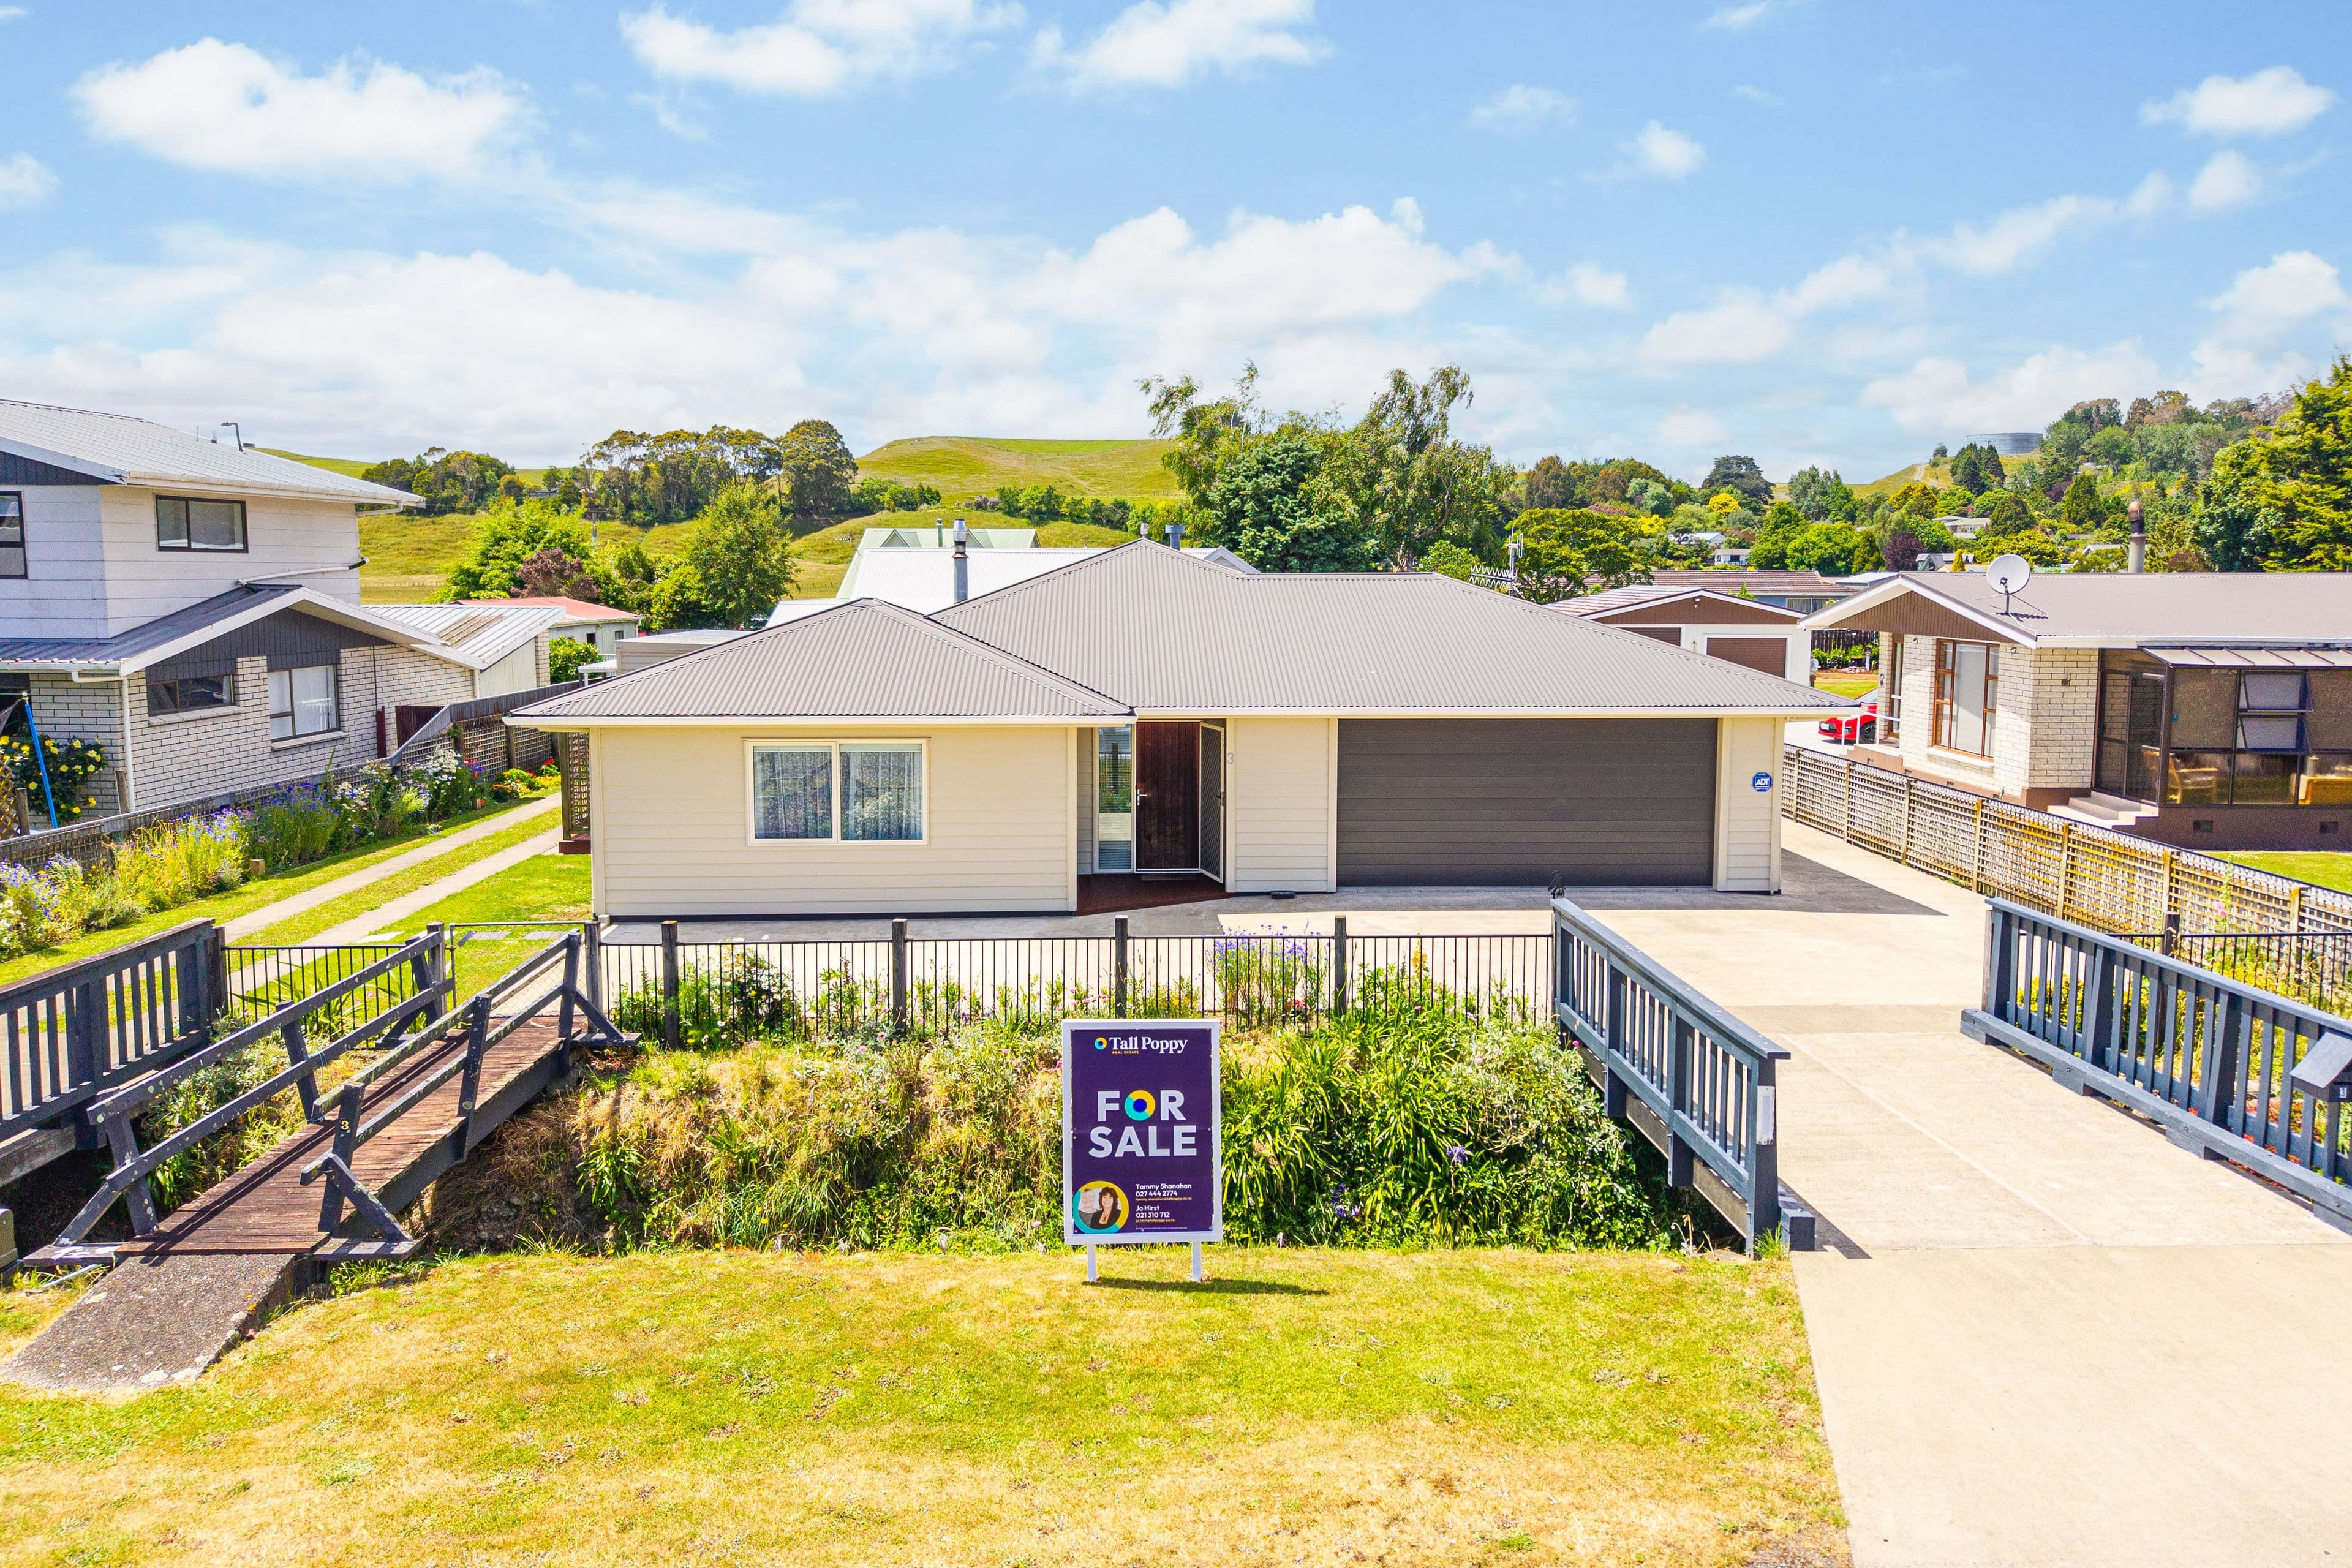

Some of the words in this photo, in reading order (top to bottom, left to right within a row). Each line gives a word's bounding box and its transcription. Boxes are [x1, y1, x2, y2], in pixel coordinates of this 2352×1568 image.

[1226, 752, 1235, 764] 3
[1109, 1036, 1139, 1050] Tall
[1141, 1036, 1188, 1054] Poppy
[2340, 1087, 2346, 1098] 3
[1097, 1090, 1186, 1121] FOR
[341, 1120, 349, 1130] 3
[1088, 1125, 1197, 1158] SALE
